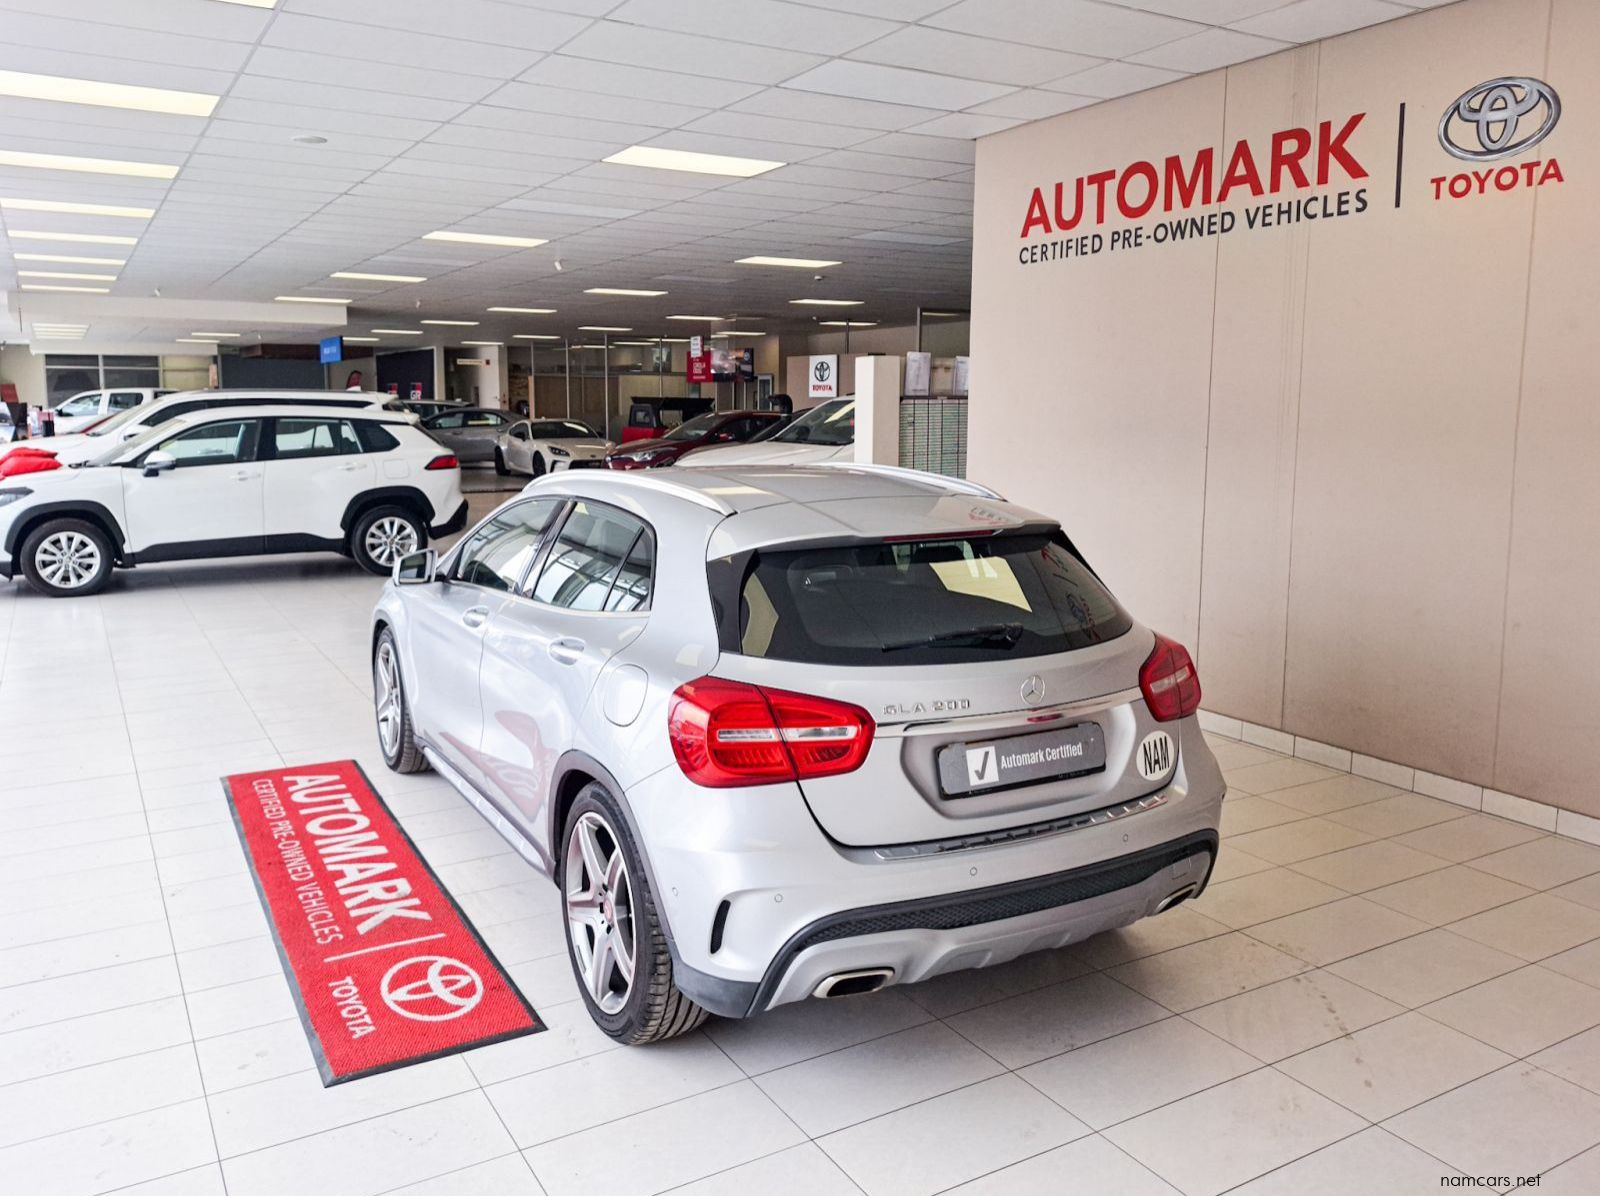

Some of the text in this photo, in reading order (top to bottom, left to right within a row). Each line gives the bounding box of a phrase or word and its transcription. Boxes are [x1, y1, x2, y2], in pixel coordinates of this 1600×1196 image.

[1021, 112, 1370, 238] AUTOMARK
[1430, 158, 1564, 200] TOYOTA
[1018, 188, 1368, 265] CERTIFIED PRE-OWNED VEHICLES
[883, 699, 970, 714] GLA 200
[1000, 741, 1083, 770] Automark Certified
[1143, 737, 1170, 776] NAM
[252, 778, 344, 945] CERTIFIED PRE-OWNED VEHICLES
[283, 774, 433, 935] AUTOMARK
[328, 975, 377, 1039] TOYOTA
